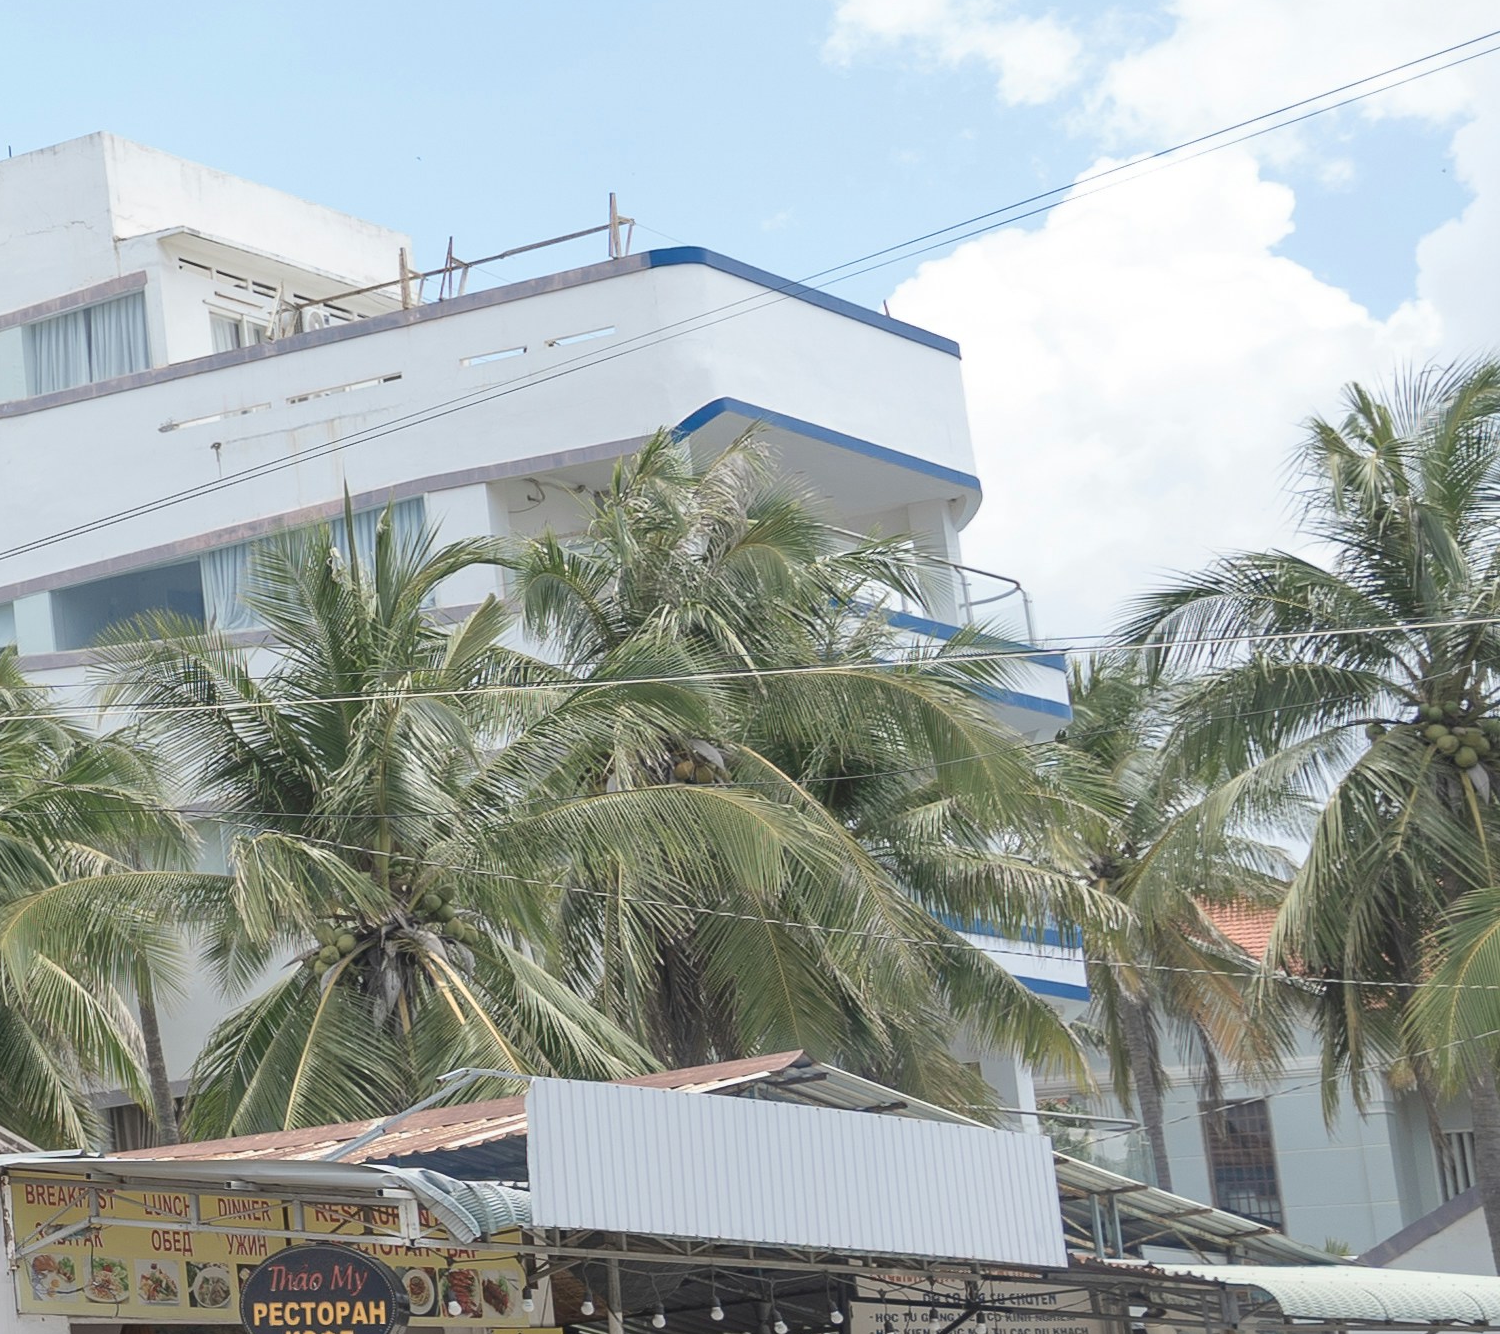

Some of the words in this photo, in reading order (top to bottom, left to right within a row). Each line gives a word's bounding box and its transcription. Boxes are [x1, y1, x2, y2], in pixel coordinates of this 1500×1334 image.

[25, 1183, 117, 1211] BREAKFST
[217, 1198, 273, 1223] DINNER
[151, 1229, 194, 1257] ОБЕД
[268, 1263, 324, 1293] Thảo
[330, 1265, 368, 1297] My
[253, 1299, 387, 1327] РЕСТОРАН
